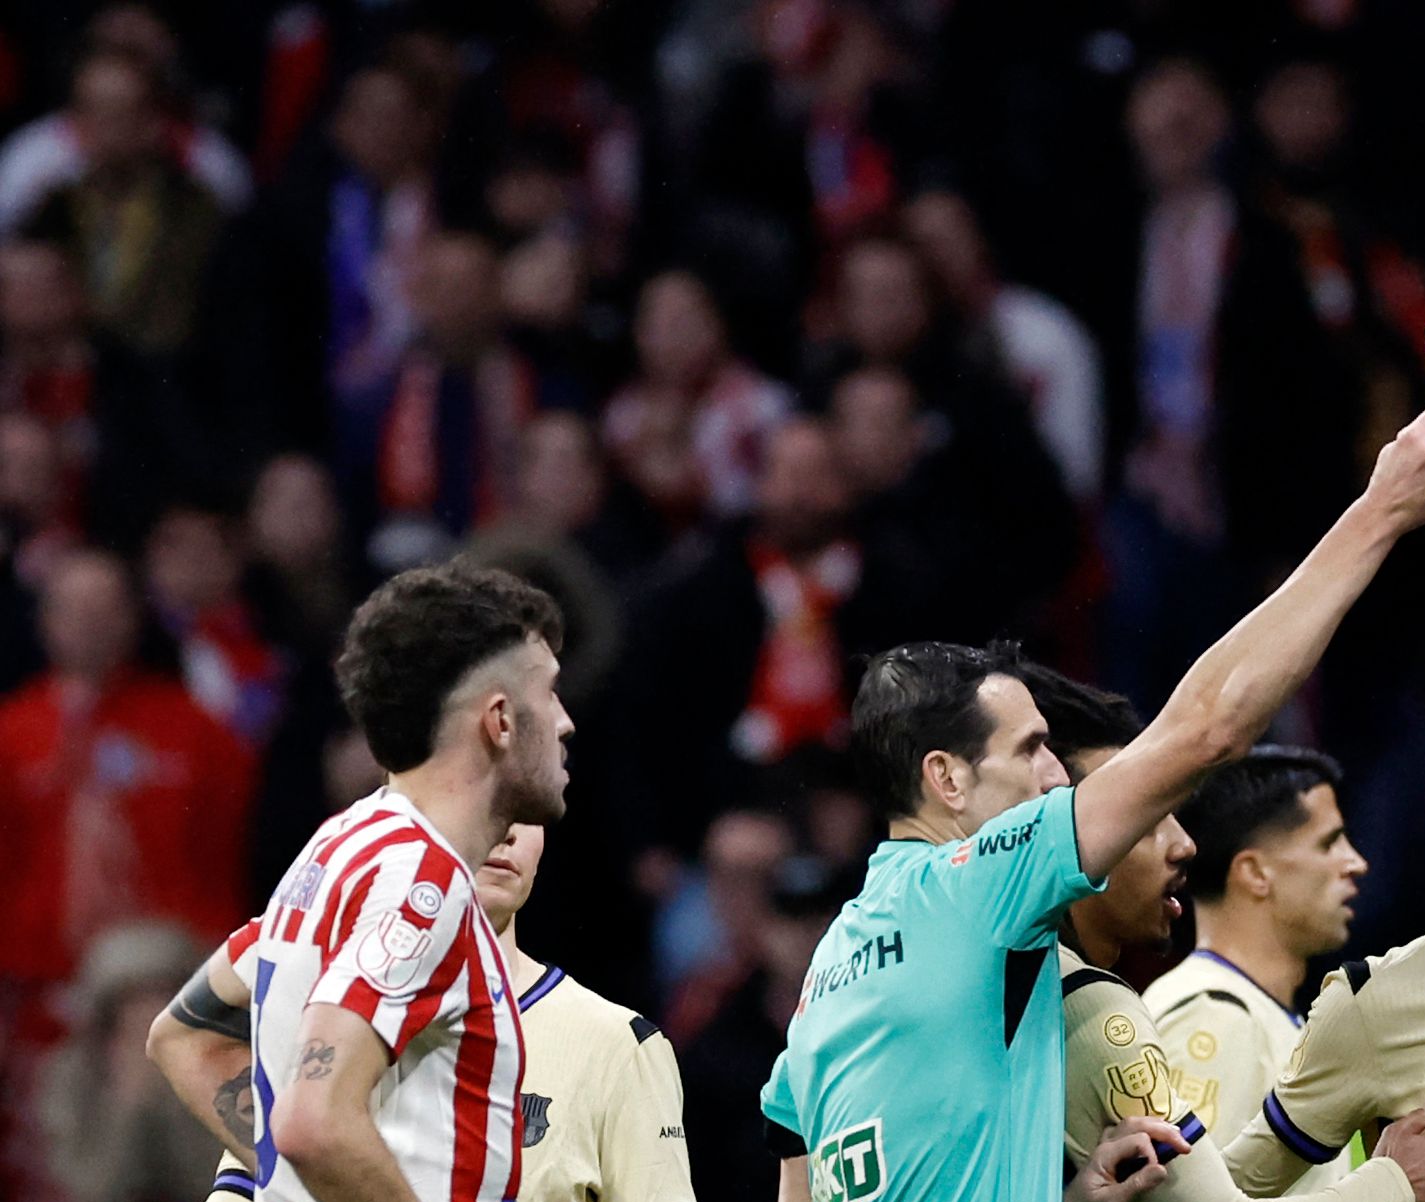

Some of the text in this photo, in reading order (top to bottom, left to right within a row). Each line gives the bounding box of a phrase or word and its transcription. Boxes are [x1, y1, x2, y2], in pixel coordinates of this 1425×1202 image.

[418, 892, 436, 908] 10
[811, 929, 904, 1003] WÜRTH
[1111, 1023, 1130, 1037] 32
